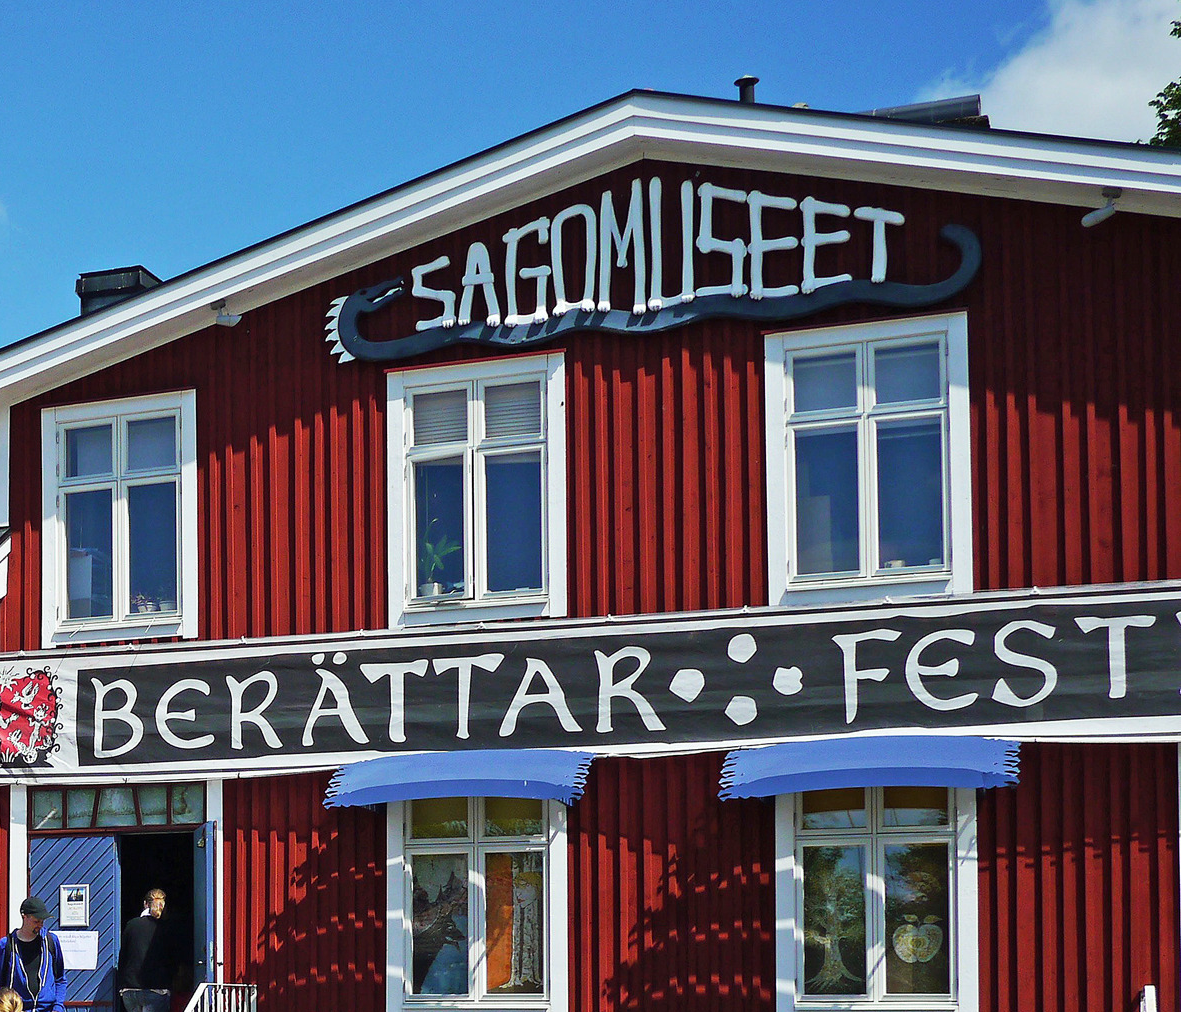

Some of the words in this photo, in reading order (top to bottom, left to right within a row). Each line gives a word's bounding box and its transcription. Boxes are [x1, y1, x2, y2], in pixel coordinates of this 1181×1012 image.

[411, 176, 905, 331] SAGOMUSEET
[91, 648, 667, 758] BERÄTTAR
[832, 611, 1181, 724] FEST
